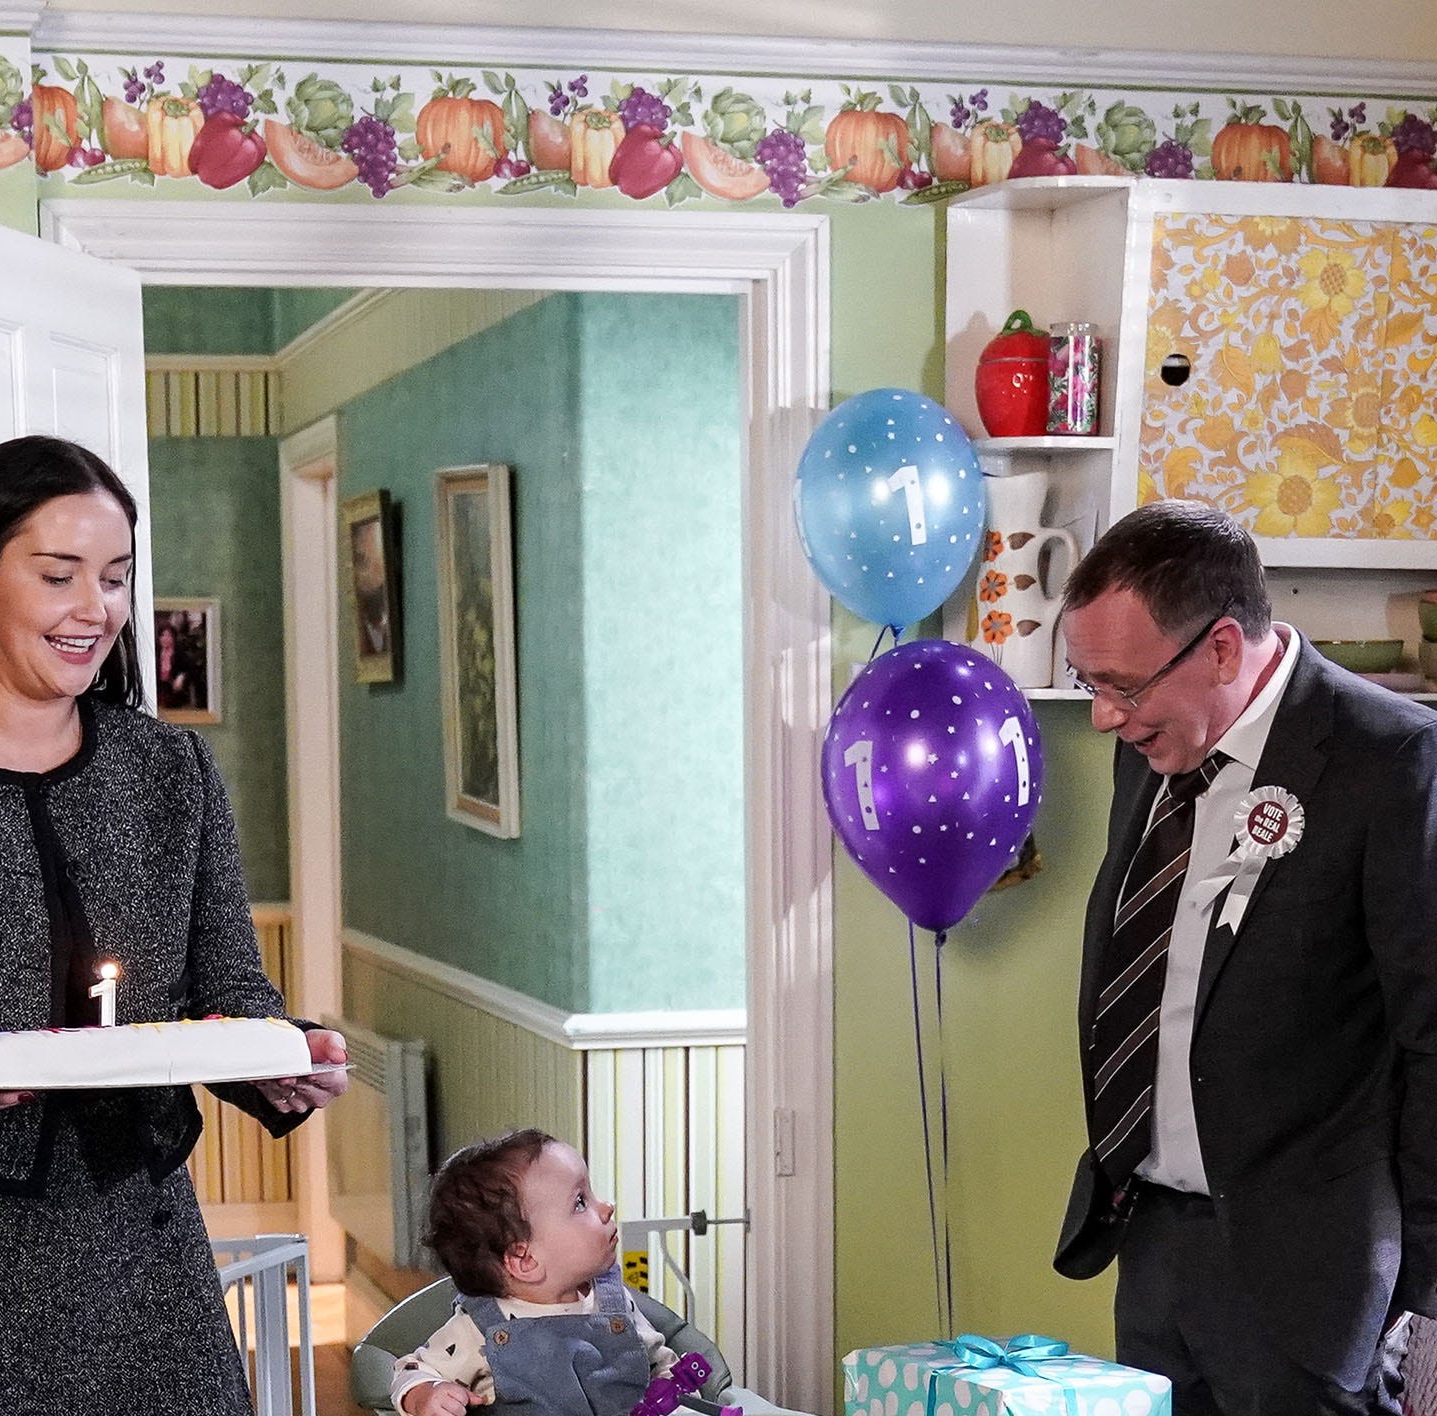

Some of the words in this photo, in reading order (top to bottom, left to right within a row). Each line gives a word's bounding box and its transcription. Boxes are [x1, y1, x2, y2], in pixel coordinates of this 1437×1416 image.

[887, 464, 927, 546] 1
[843, 740, 880, 831] 1
[998, 715, 1030, 807] 1
[1251, 825, 1274, 843] BEALE
[1262, 802, 1284, 821] VOTE
[1262, 817, 1281, 833] REAL
[88, 979, 116, 1028] 1
